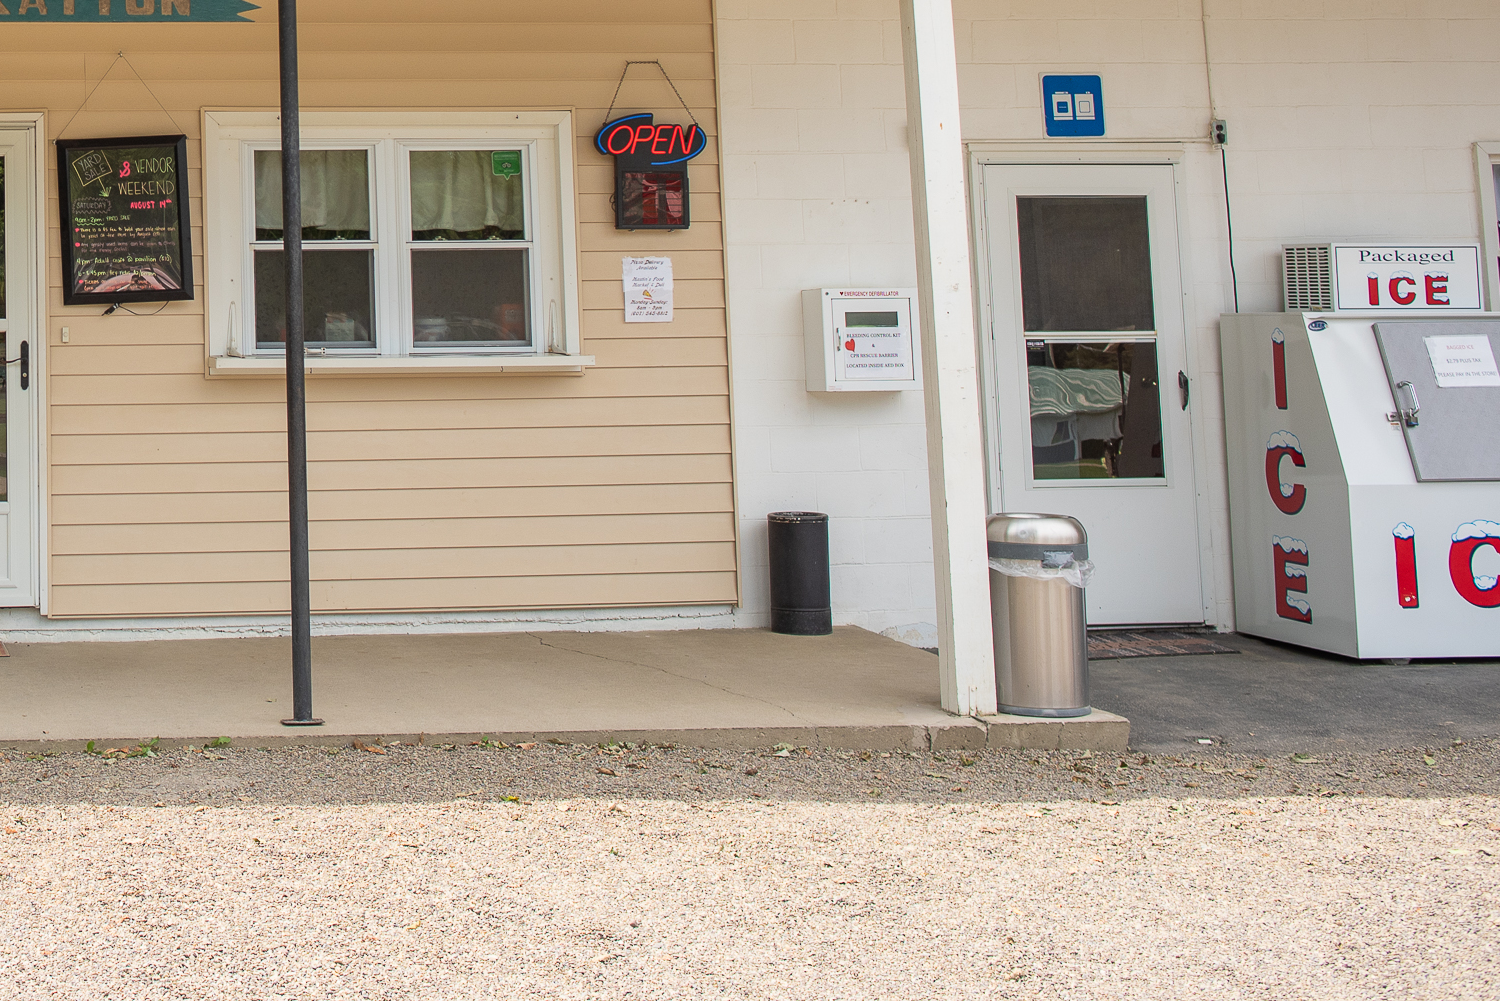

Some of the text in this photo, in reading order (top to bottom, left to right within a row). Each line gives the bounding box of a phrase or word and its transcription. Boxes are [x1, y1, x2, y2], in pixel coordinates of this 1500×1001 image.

[607, 125, 697, 155] OPEN
[78, 154, 102, 172] YARD
[134, 157, 174, 173] VENDOR
[84, 163, 106, 180] SALE
[118, 180, 175, 195] WEEKEND
[130, 201, 155, 209] AUGUST
[1358, 250, 1455, 265] Packaged
[1366, 270, 1450, 306] ICE
